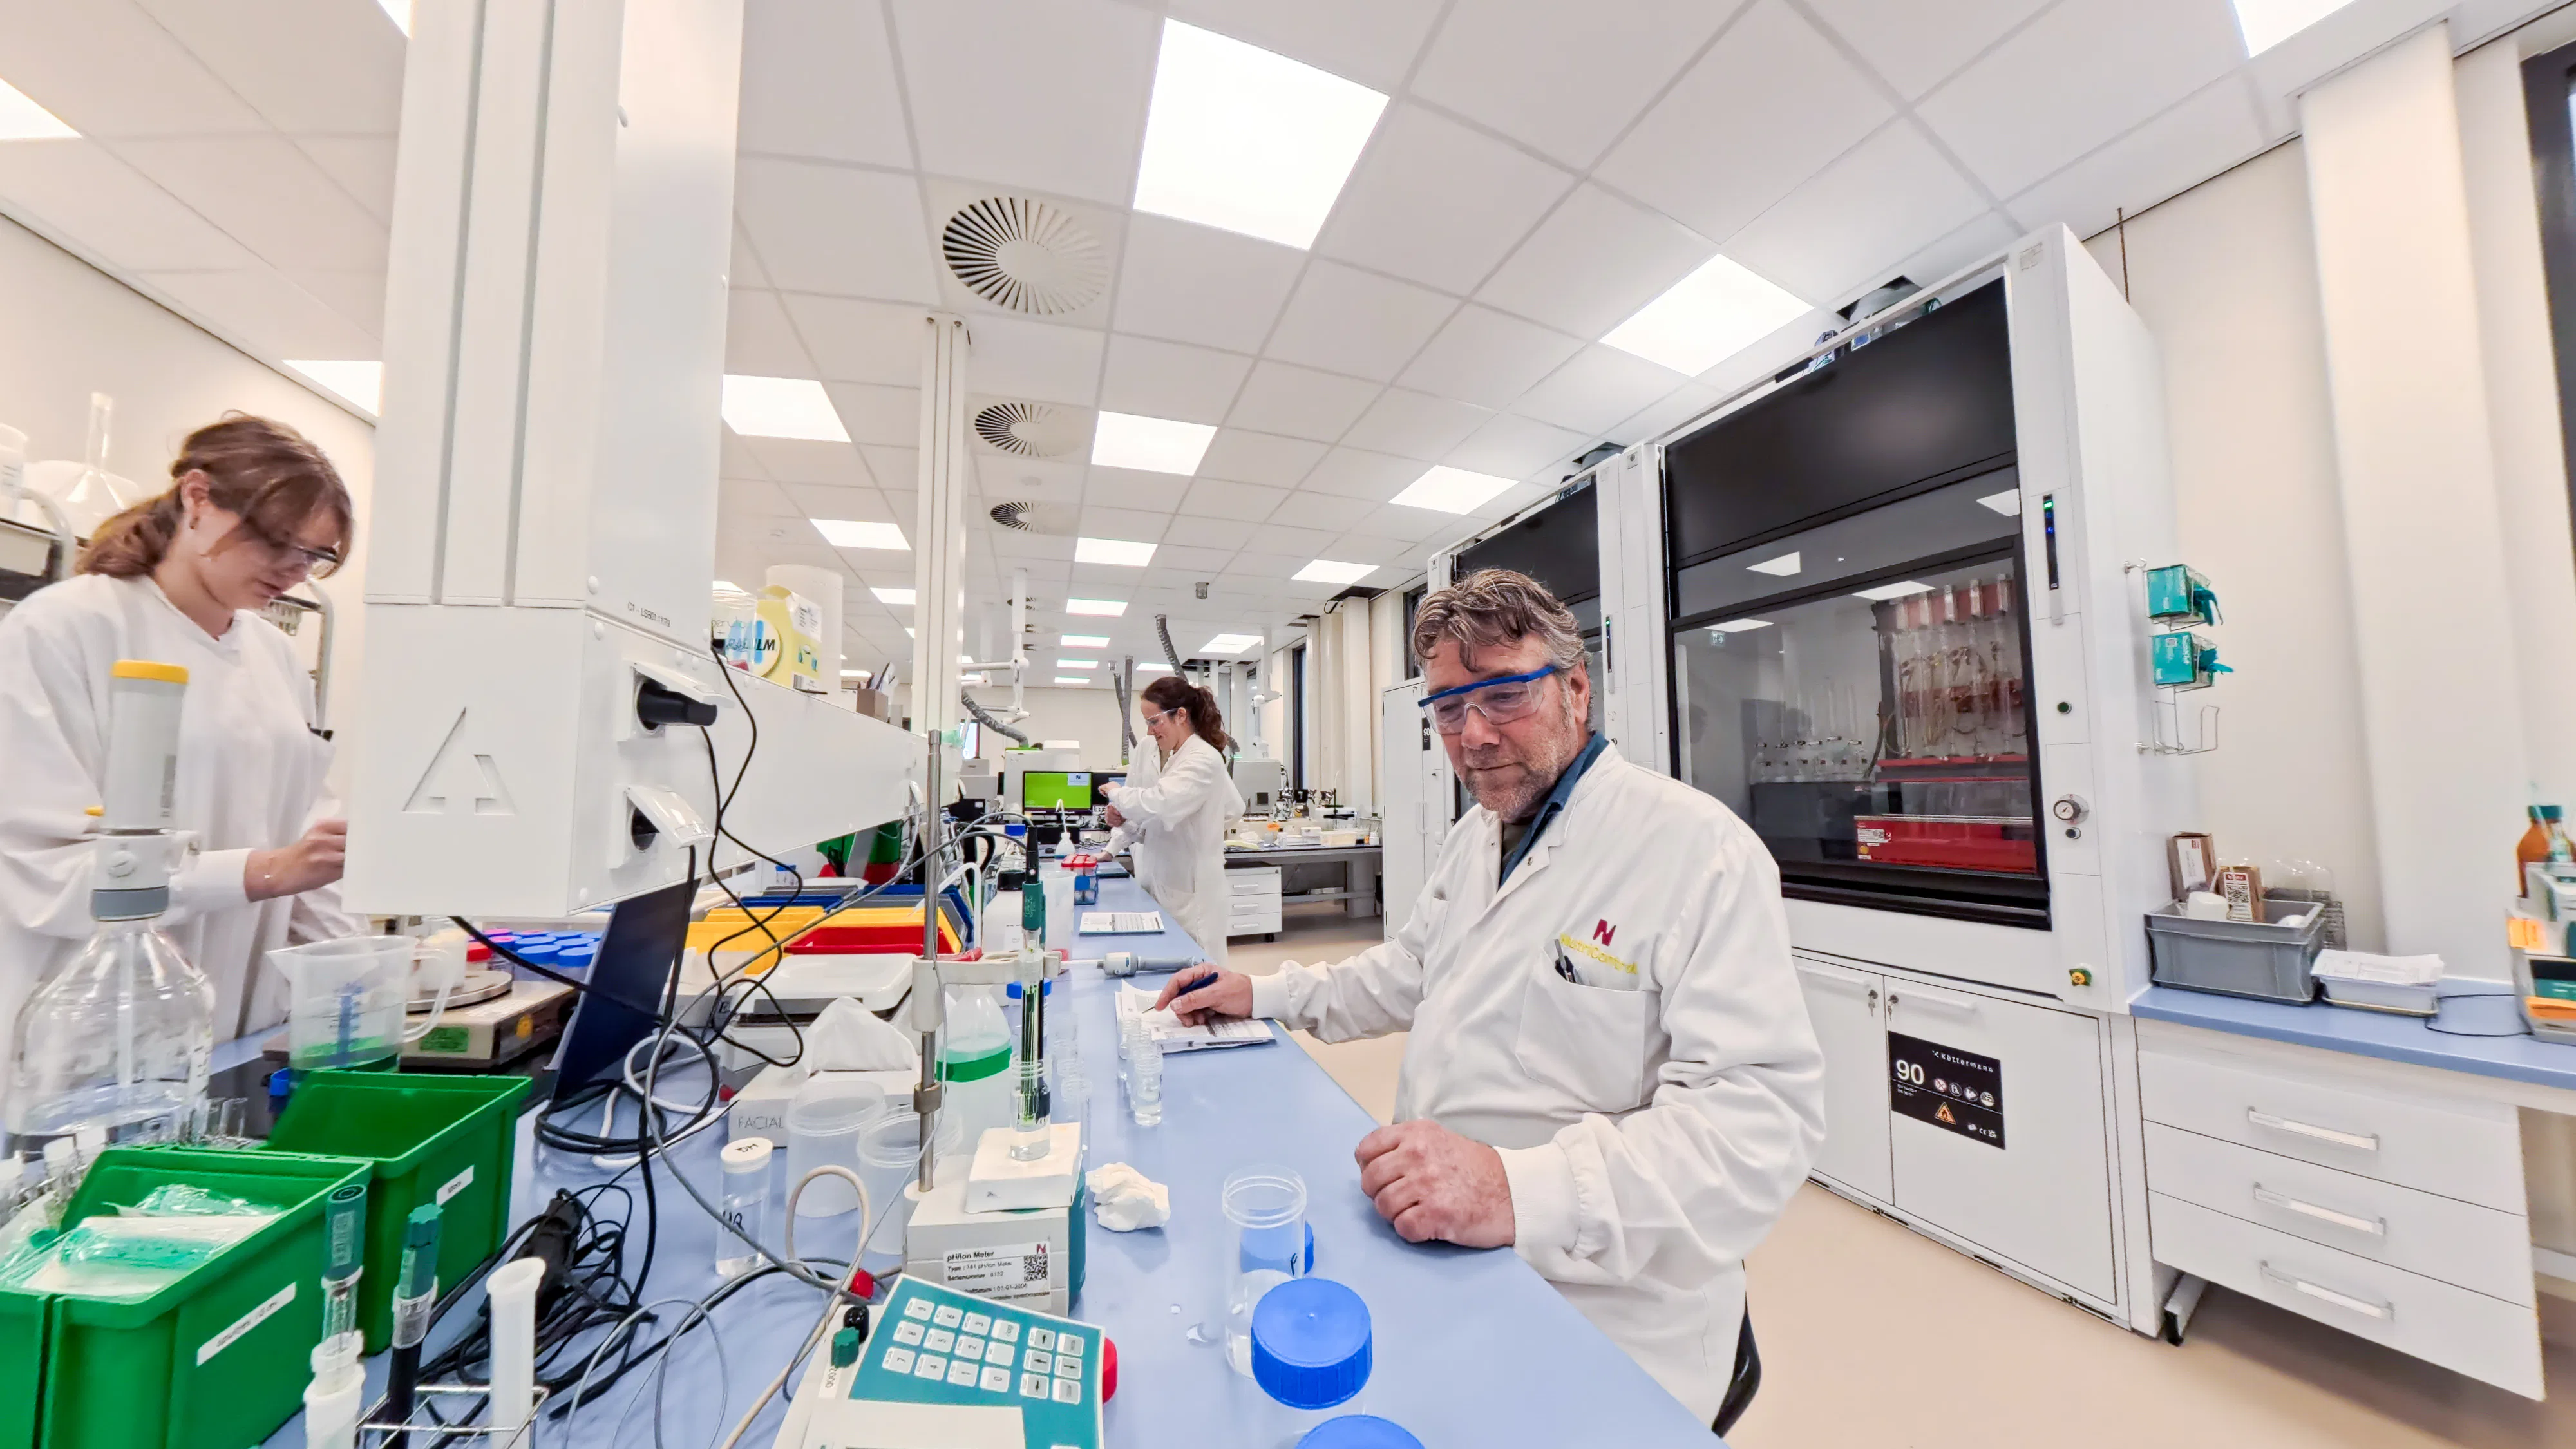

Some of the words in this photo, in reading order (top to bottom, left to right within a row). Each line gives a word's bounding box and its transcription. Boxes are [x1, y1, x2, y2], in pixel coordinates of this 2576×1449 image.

[1423, 728, 1430, 736] 90
[1896, 1059, 1925, 1085] 90
[737, 1115, 784, 1130] FACIAL
